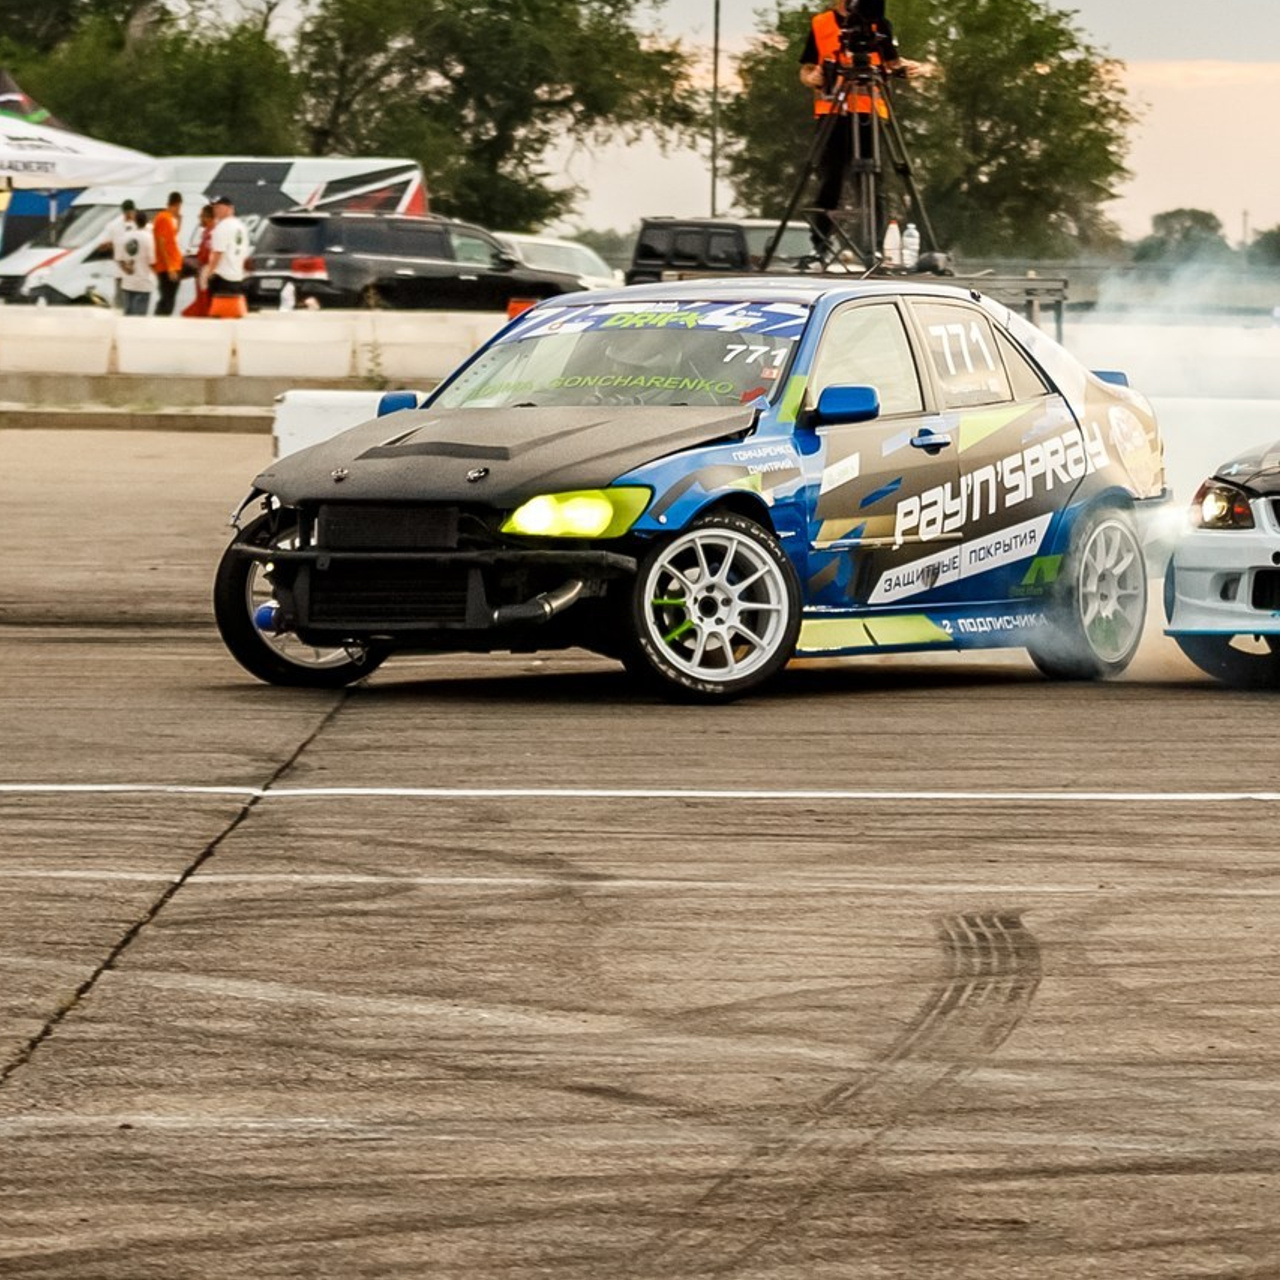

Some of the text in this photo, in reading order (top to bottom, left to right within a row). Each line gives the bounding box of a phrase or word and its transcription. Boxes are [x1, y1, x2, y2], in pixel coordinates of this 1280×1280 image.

[723, 344, 788, 367] 771
[928, 321, 996, 376] 771
[549, 375, 734, 395] GONCHARENKO
[883, 528, 1038, 593] ЗАЩИТНЫЕ ПОКРЫТИЯ
[941, 614, 1049, 634] 2 ПОДПИСЧИКА
